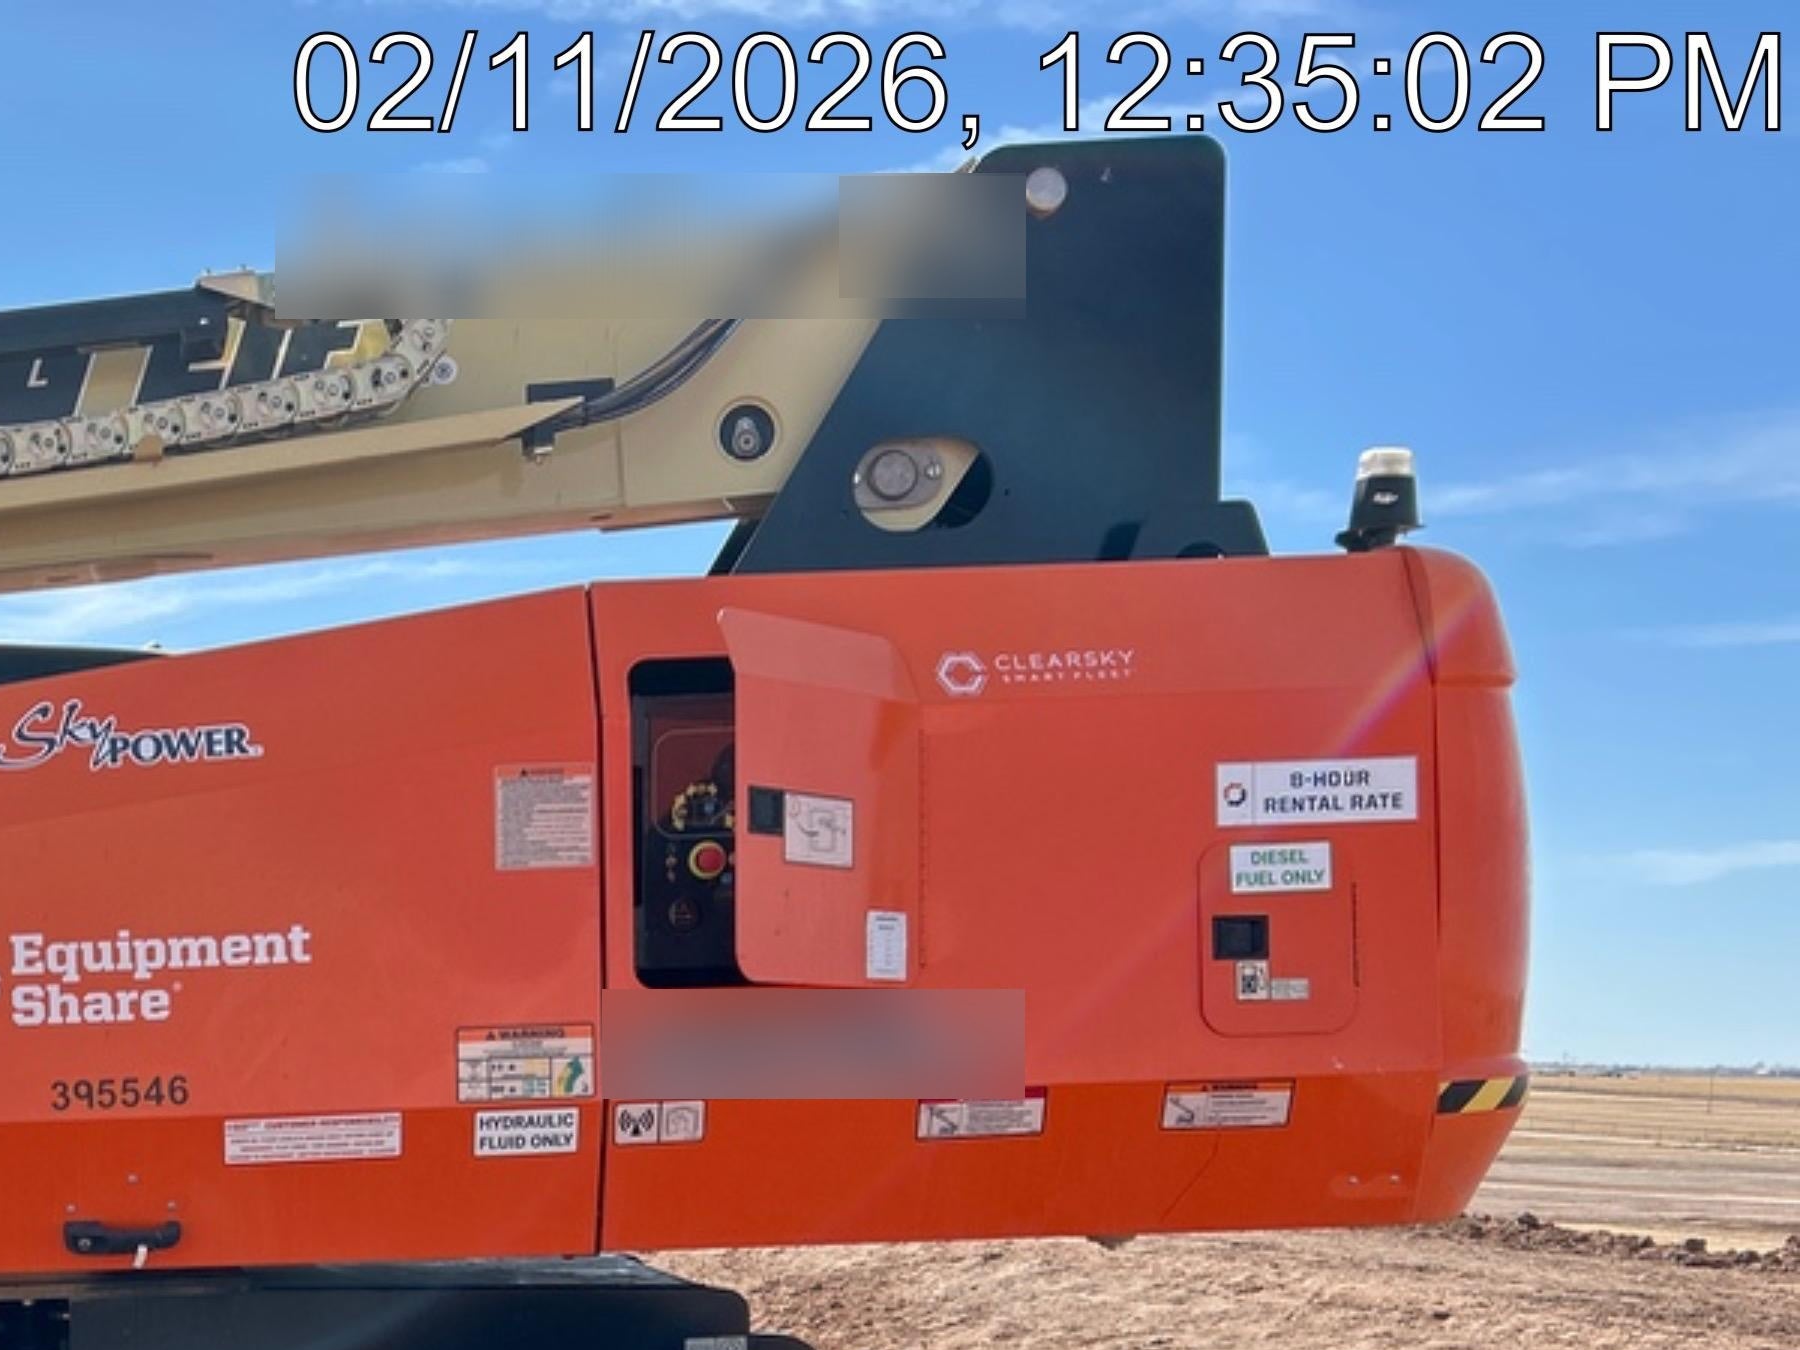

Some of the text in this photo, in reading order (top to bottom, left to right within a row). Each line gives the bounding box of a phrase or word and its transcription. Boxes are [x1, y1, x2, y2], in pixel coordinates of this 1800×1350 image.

[994, 648, 1135, 671] CLEARSKY
[1288, 769, 1370, 790] 8-HOUR
[1263, 791, 1404, 814] RENTAL RATE
[1250, 849, 1309, 866] DIESEL
[1235, 868, 1326, 888] FUEL ONLY
[9, 925, 313, 982] Equipment
[10, 982, 171, 1027] Share
[50, 1075, 190, 1111] 395546
[478, 1112, 575, 1131] HYDRAULIC
[478, 1133, 574, 1151] FLUID ONLY
